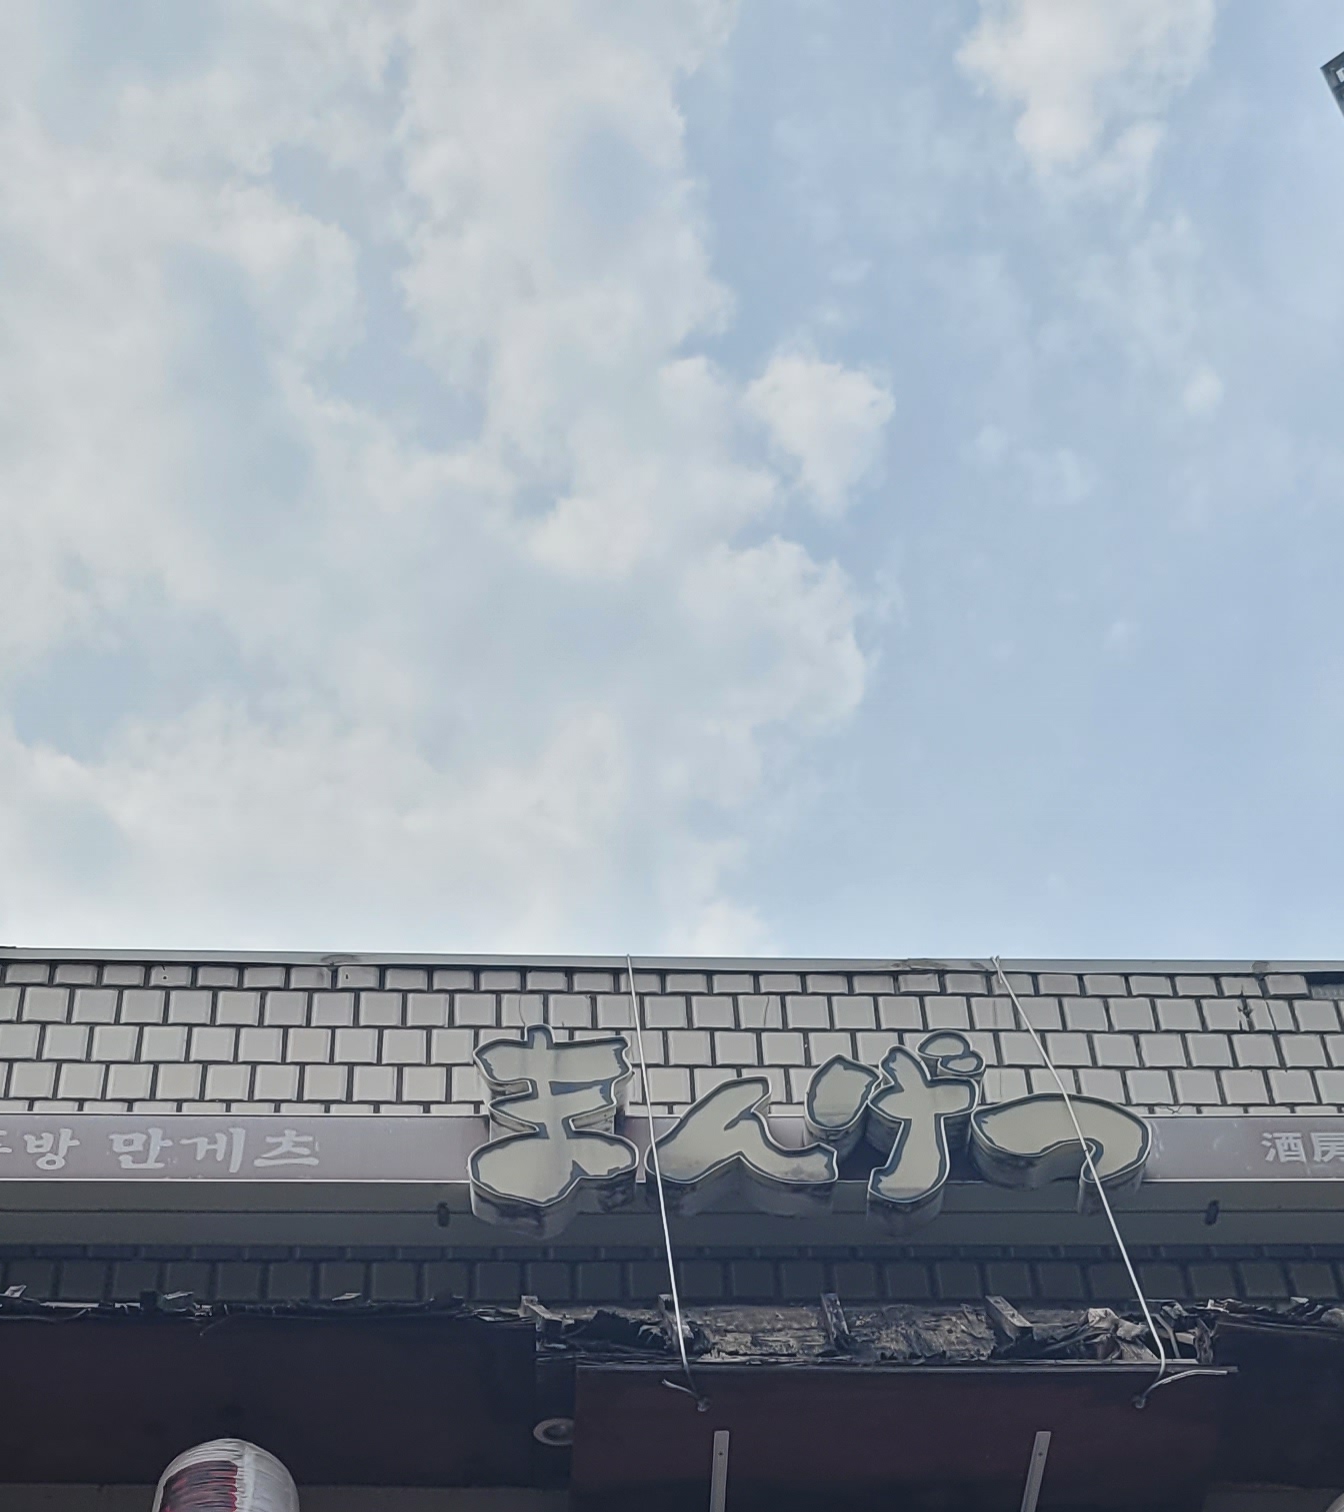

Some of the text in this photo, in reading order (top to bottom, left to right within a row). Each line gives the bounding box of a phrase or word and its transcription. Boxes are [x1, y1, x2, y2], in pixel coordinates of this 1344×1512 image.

[108, 1127, 320, 1174] 만게츠
[468, 1024, 1152, 1212] まんげつ
